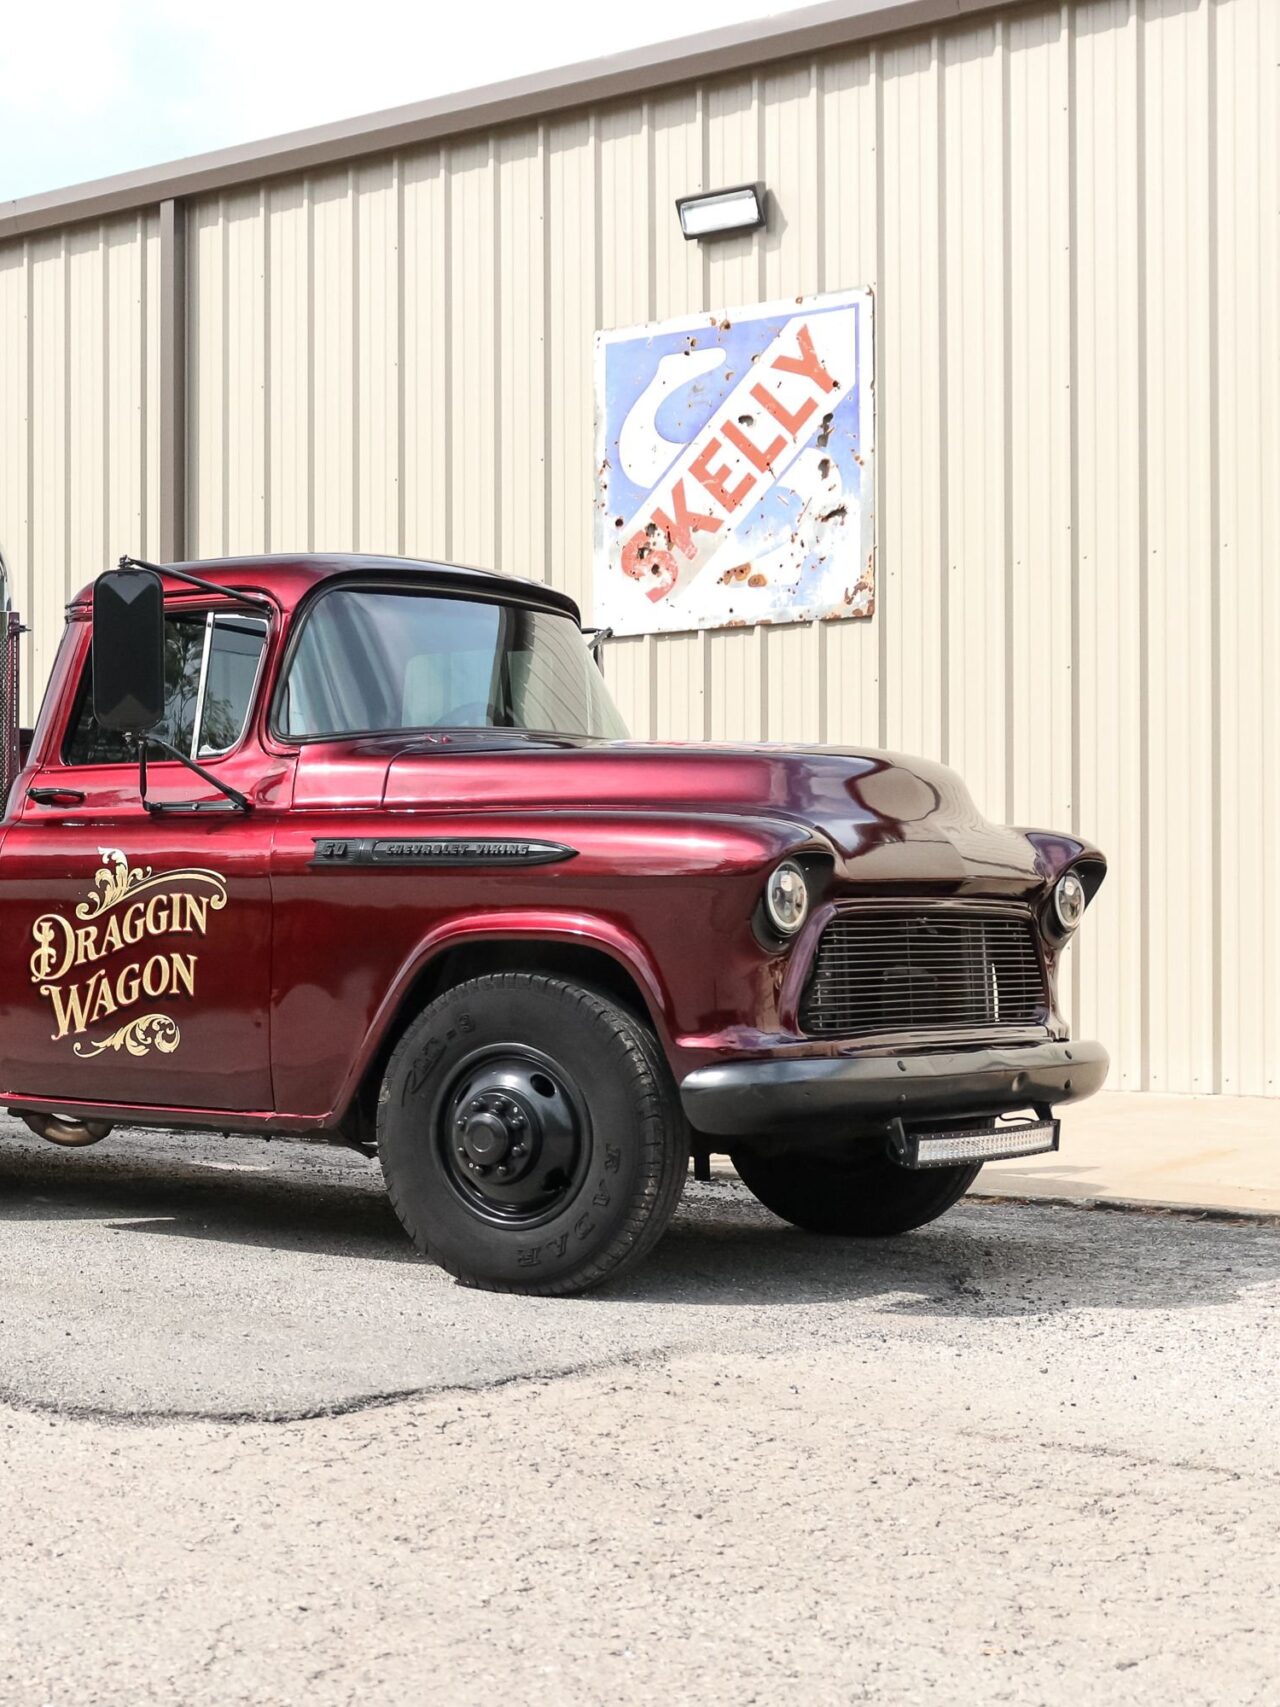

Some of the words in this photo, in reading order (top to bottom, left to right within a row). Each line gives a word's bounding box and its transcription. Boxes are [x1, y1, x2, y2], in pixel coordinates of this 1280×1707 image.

[621, 323, 837, 603] SKELLY
[385, 844, 469, 855] CHEVROLET
[476, 844, 529, 855] VIKING
[30, 893, 209, 983] DRAGGIN
[40, 953, 198, 1040] WAGON
